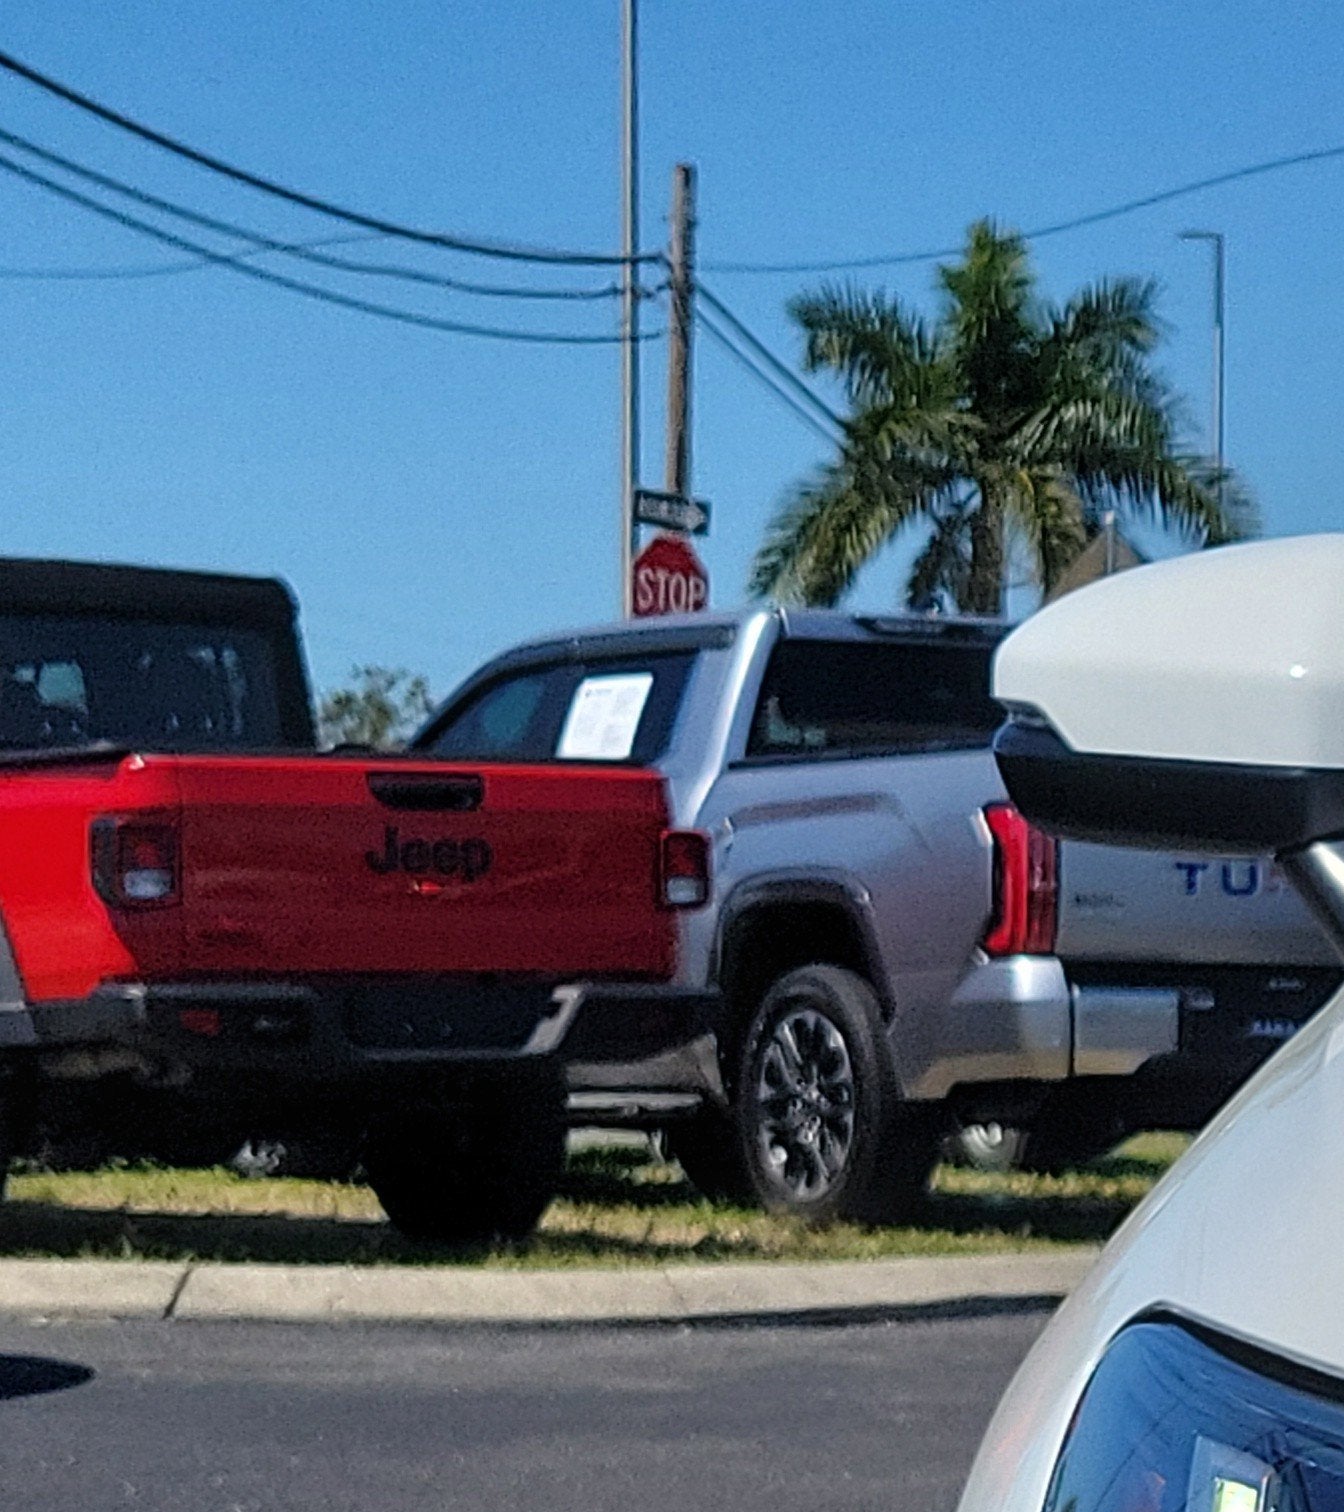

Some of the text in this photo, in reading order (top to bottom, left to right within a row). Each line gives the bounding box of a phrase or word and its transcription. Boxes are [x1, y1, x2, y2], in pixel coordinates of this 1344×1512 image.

[635, 567, 706, 613] STOP
[365, 825, 493, 882] Jeep
[1175, 861, 1284, 896] TU
